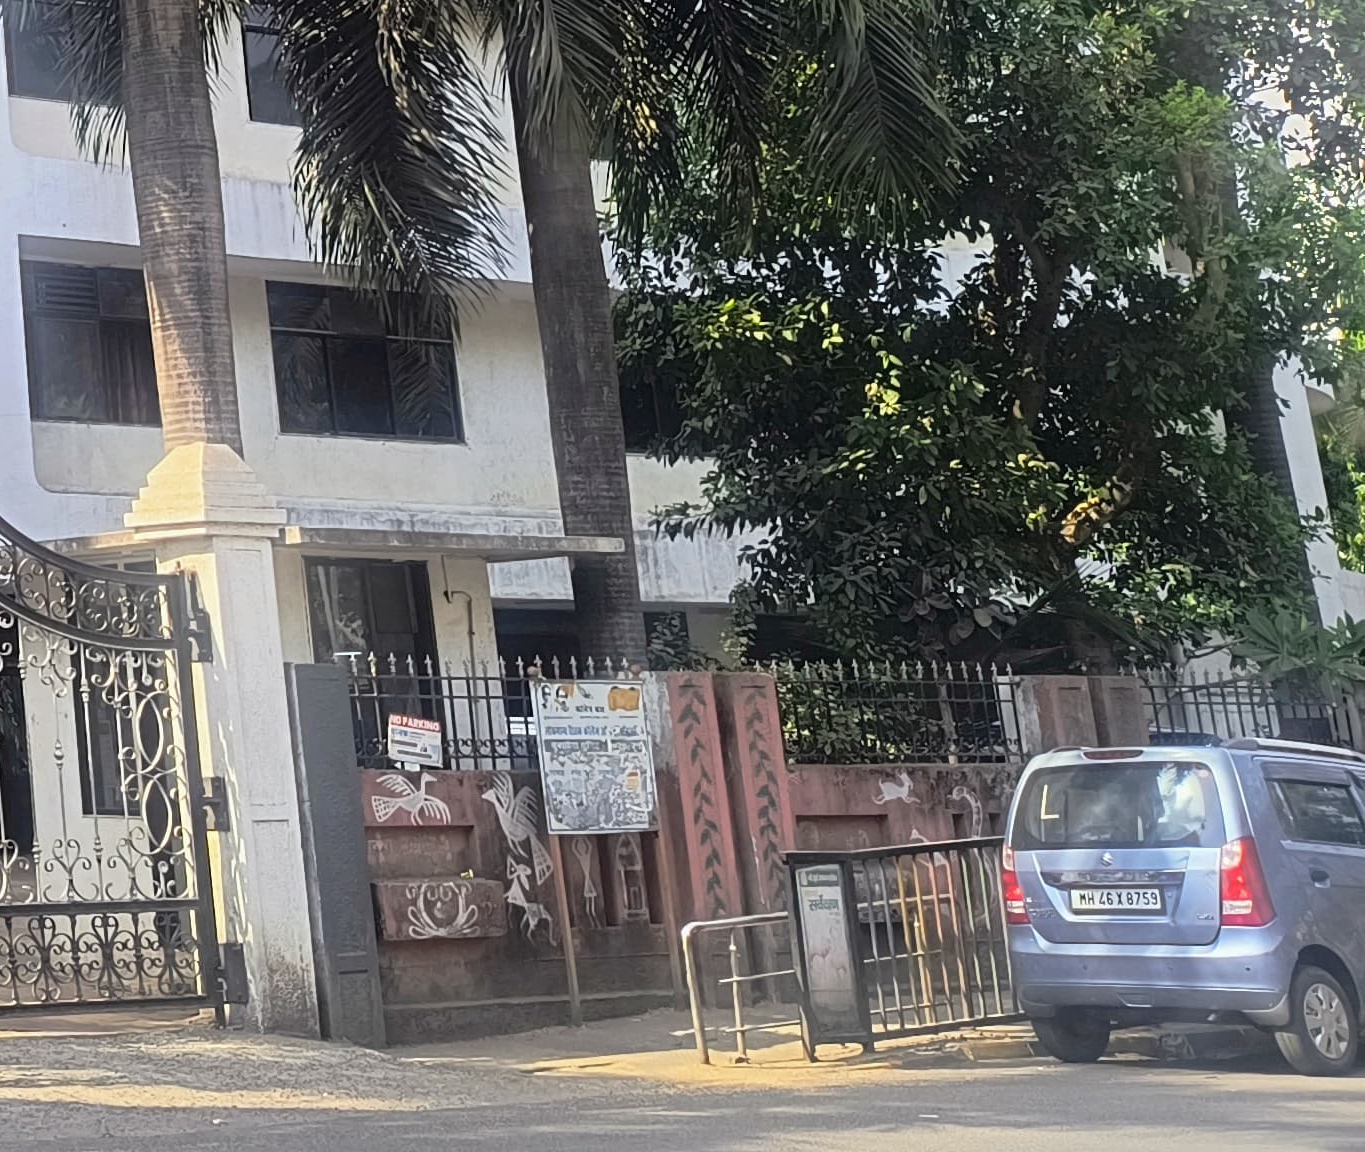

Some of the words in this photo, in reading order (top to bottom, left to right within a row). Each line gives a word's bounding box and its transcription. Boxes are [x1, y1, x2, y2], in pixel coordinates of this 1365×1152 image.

[403, 717, 439, 731] PARKING
[1079, 891, 1095, 906] MH
[1099, 891, 1114, 906] 46
[1116, 891, 1124, 906] X
[1127, 891, 1158, 906] 8759
